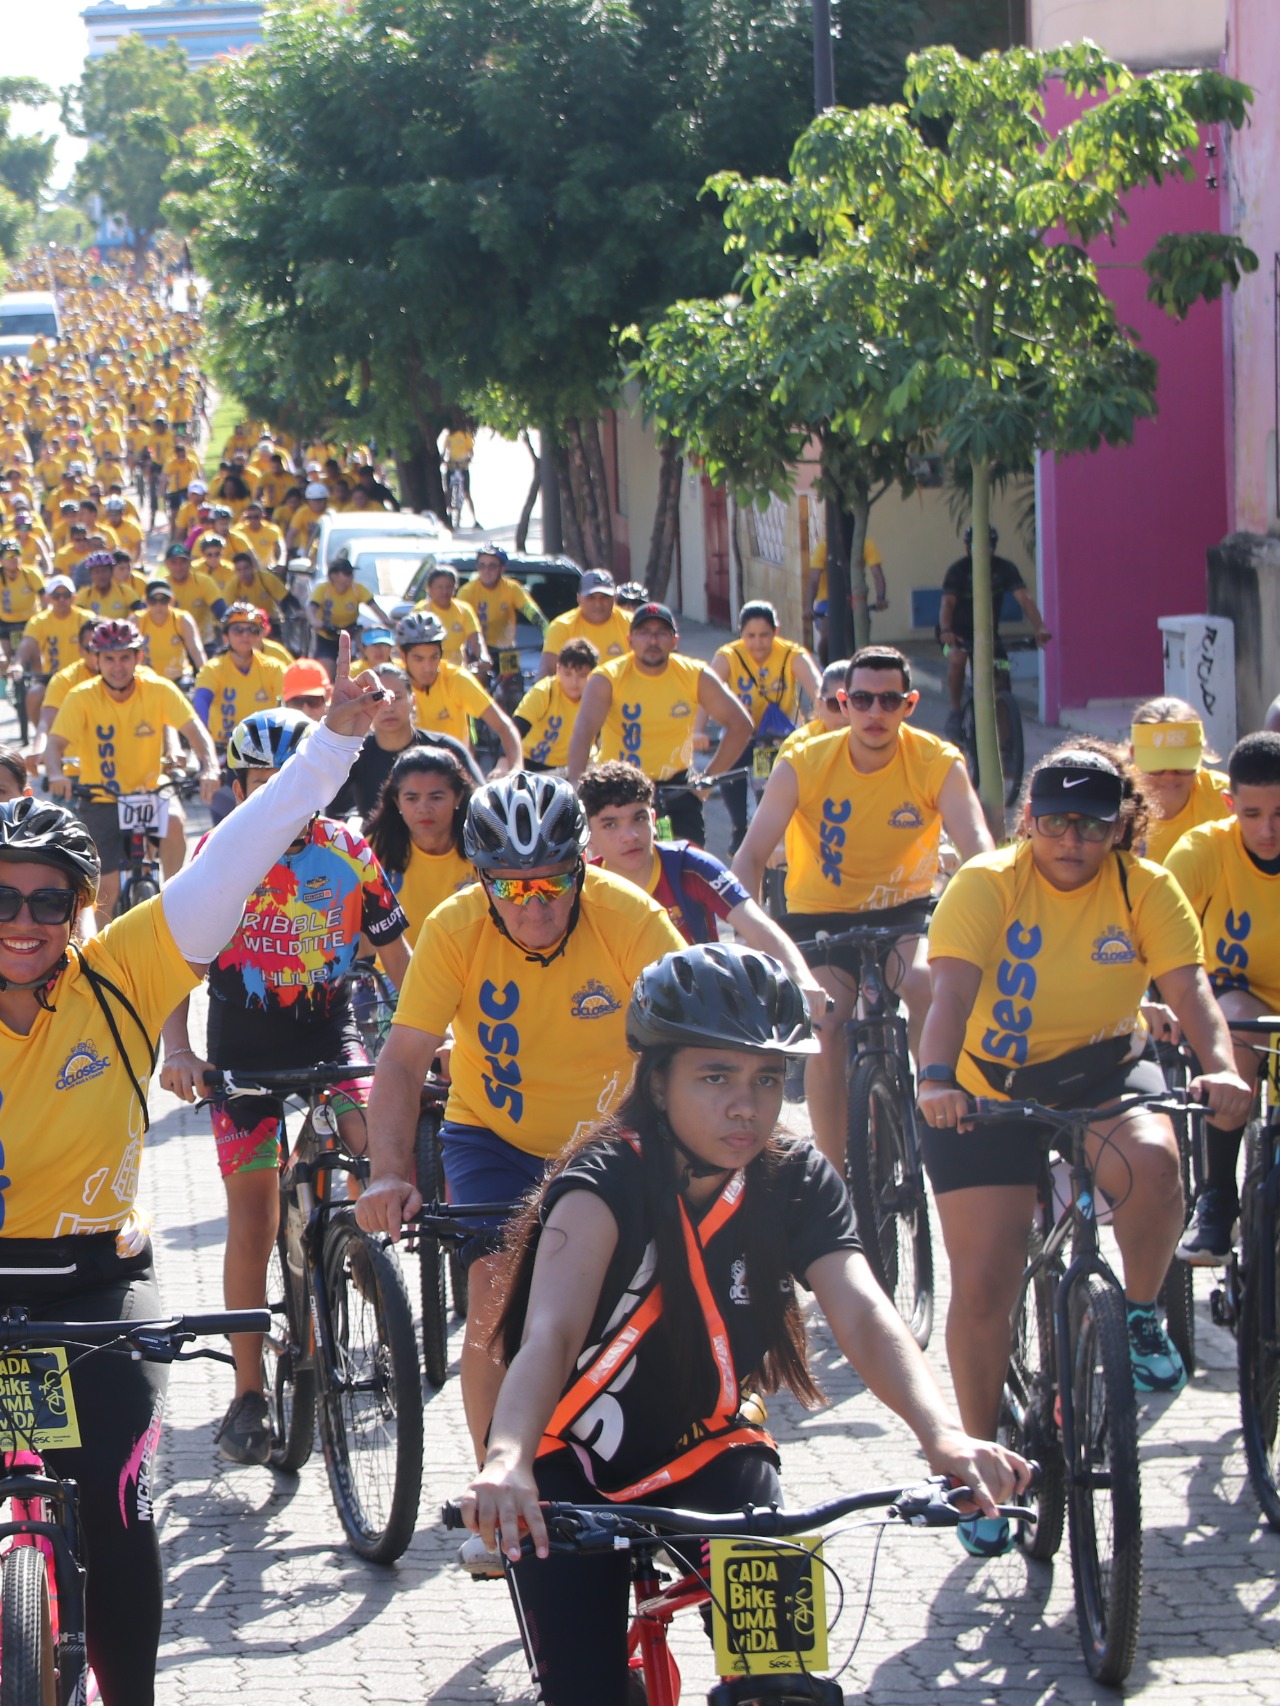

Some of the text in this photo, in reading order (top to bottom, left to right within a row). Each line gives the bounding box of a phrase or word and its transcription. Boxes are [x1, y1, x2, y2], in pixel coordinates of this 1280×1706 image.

[123, 804, 154, 825] 010
[242, 906, 343, 935] RIBBLE
[243, 931, 345, 956] WELDTITE
[55, 1056, 111, 1091] CICLOSESC
[727, 1560, 779, 1583] CADA
[732, 1608, 778, 1630] UMA
